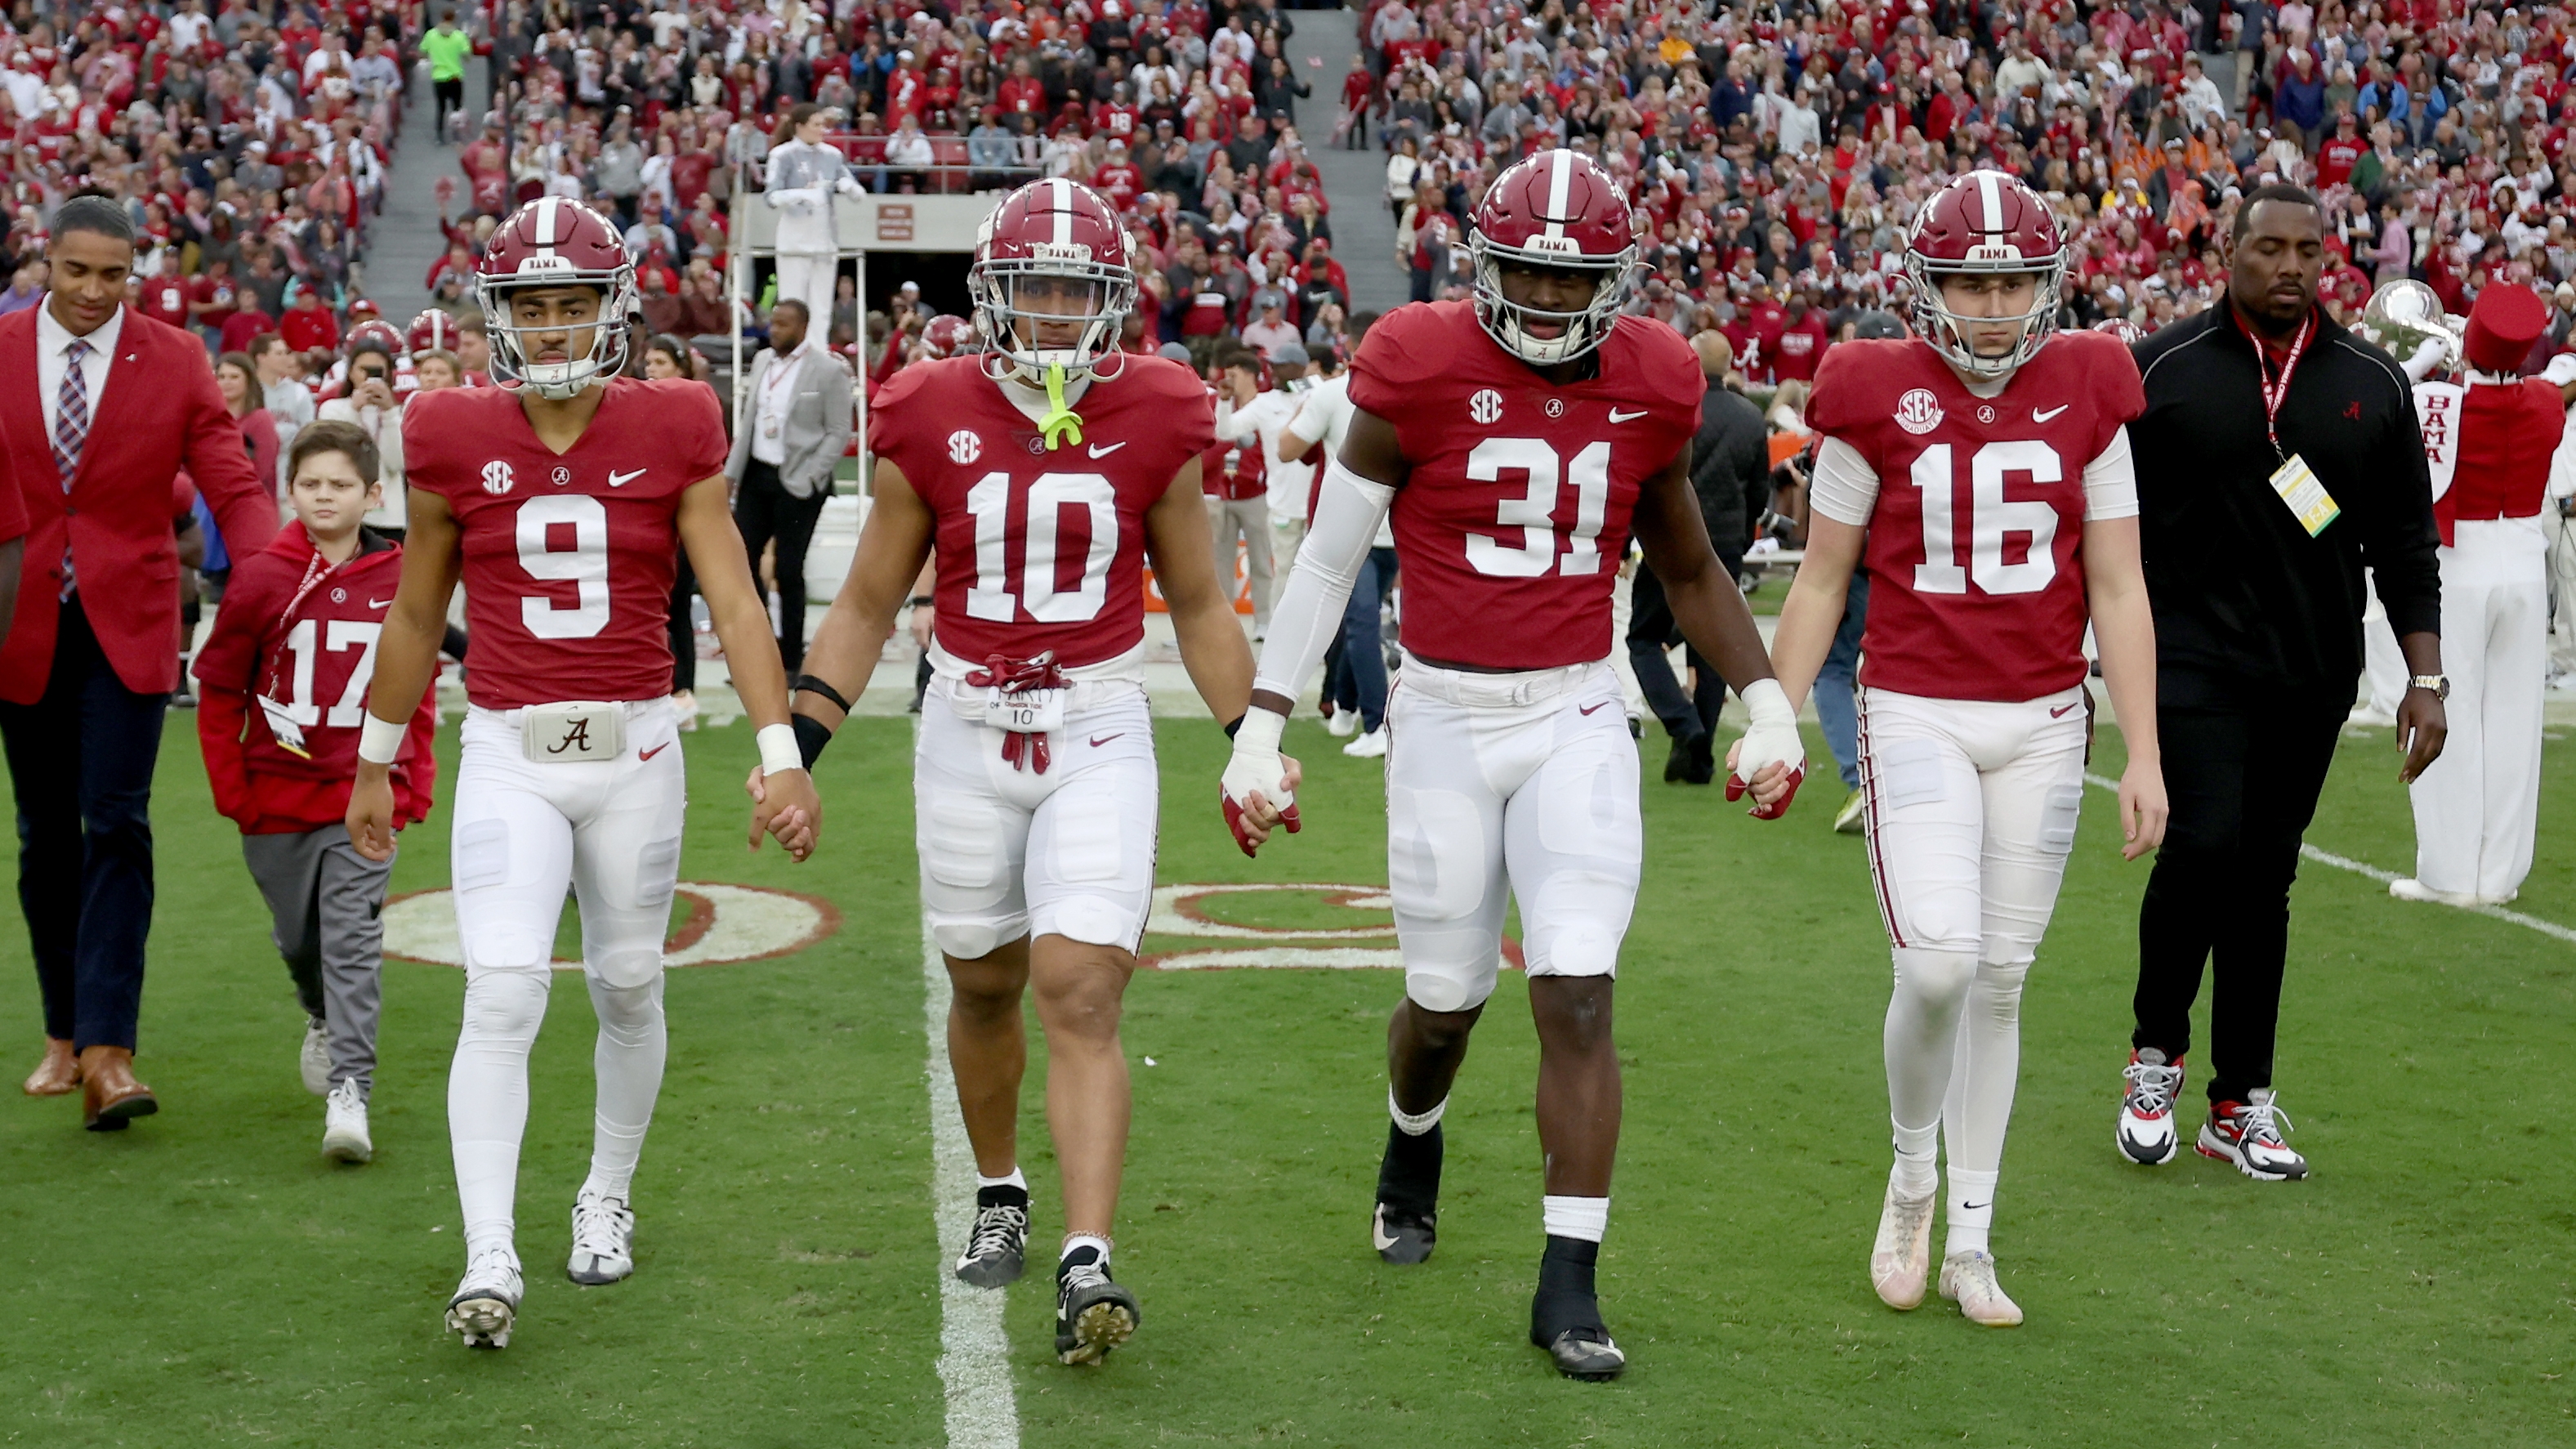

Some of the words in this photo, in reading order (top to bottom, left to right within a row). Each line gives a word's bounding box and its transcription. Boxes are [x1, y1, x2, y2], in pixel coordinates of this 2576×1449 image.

[1109, 113, 1132, 133] 18
[1048, 248, 1076, 258] BAMA
[1538, 239, 1567, 251] BAMA
[1979, 248, 2008, 259] BAMA
[529, 259, 558, 269] BAMA
[161, 288, 181, 311] 9
[2280, 353, 2297, 385] ALABAMA
[1470, 389, 1503, 423] SEC
[1902, 391, 1934, 423] SEC
[1900, 416, 1939, 433] GRADUATE
[2422, 395, 2450, 463] BAMA
[948, 430, 982, 465] SEC
[480, 460, 515, 494] SEC
[1465, 437, 1611, 577] 31
[1910, 440, 2063, 595] 16
[967, 472, 1118, 623] 10
[516, 494, 610, 639] 9
[287, 619, 383, 727] 17
[1013, 709, 1034, 725] 10
[547, 717, 592, 754] A
